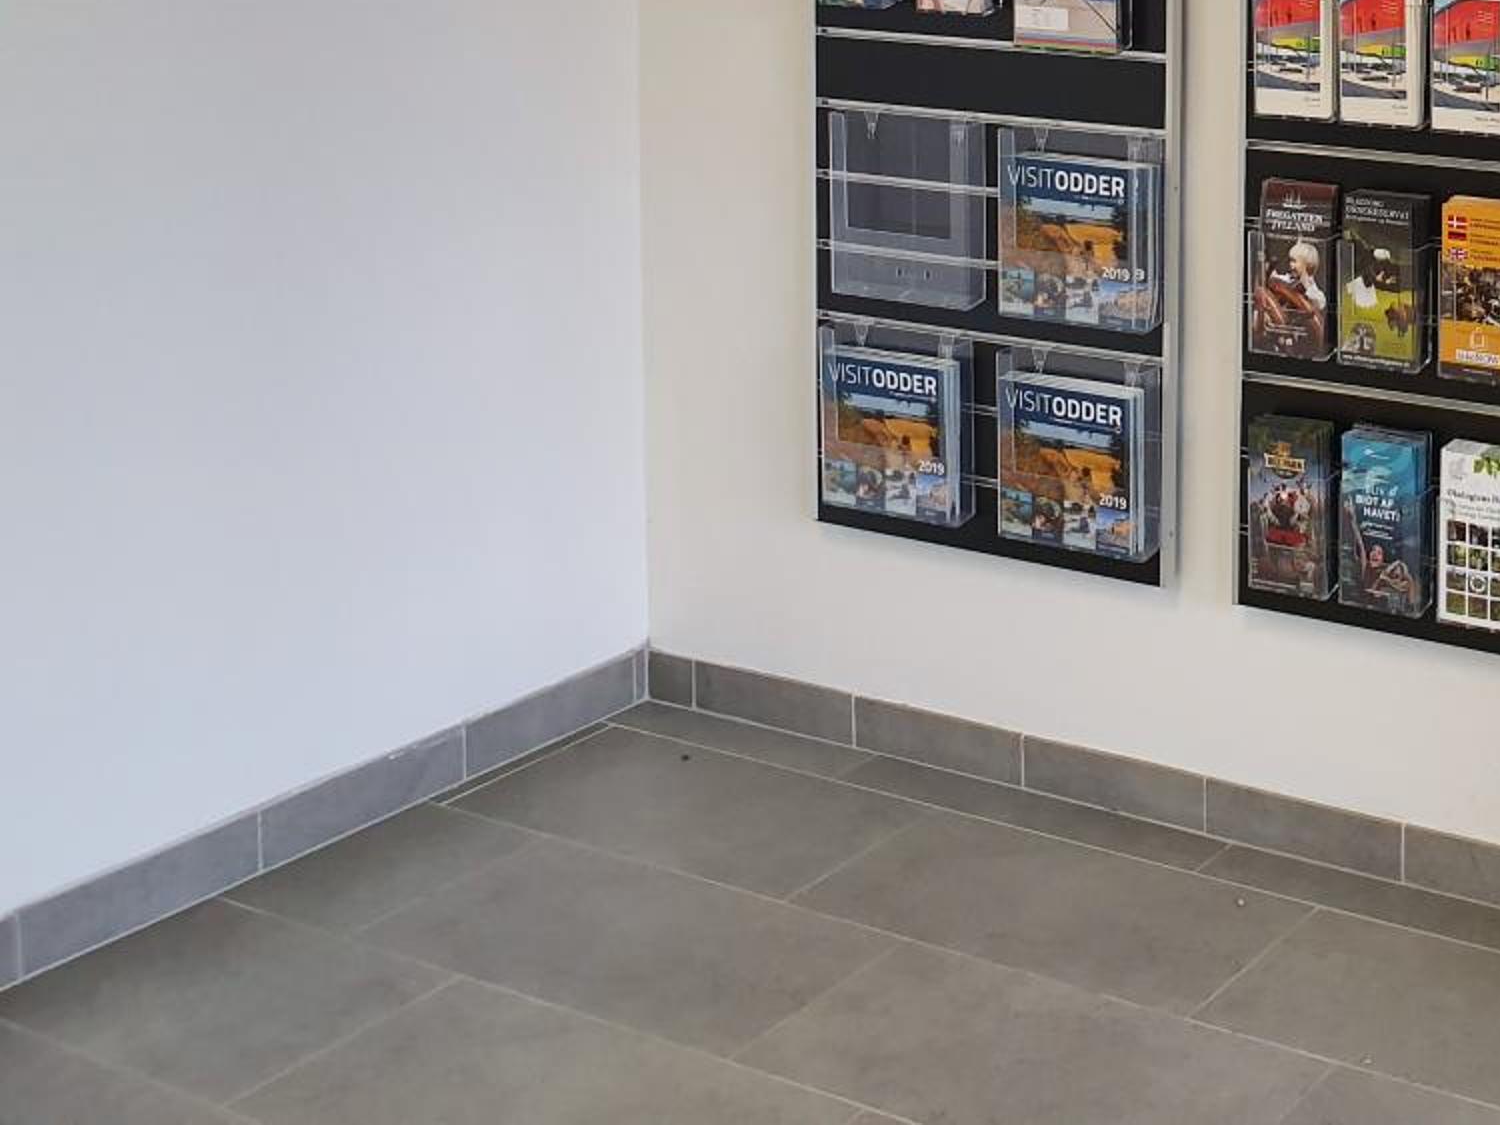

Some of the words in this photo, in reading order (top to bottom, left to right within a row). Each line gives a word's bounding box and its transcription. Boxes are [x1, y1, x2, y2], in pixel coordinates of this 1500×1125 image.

[1265, 208, 1324, 224] FREGATTEN
[1102, 266, 1131, 282] 2019
[918, 459, 945, 476] 2019
[1099, 493, 1128, 510] 2019
